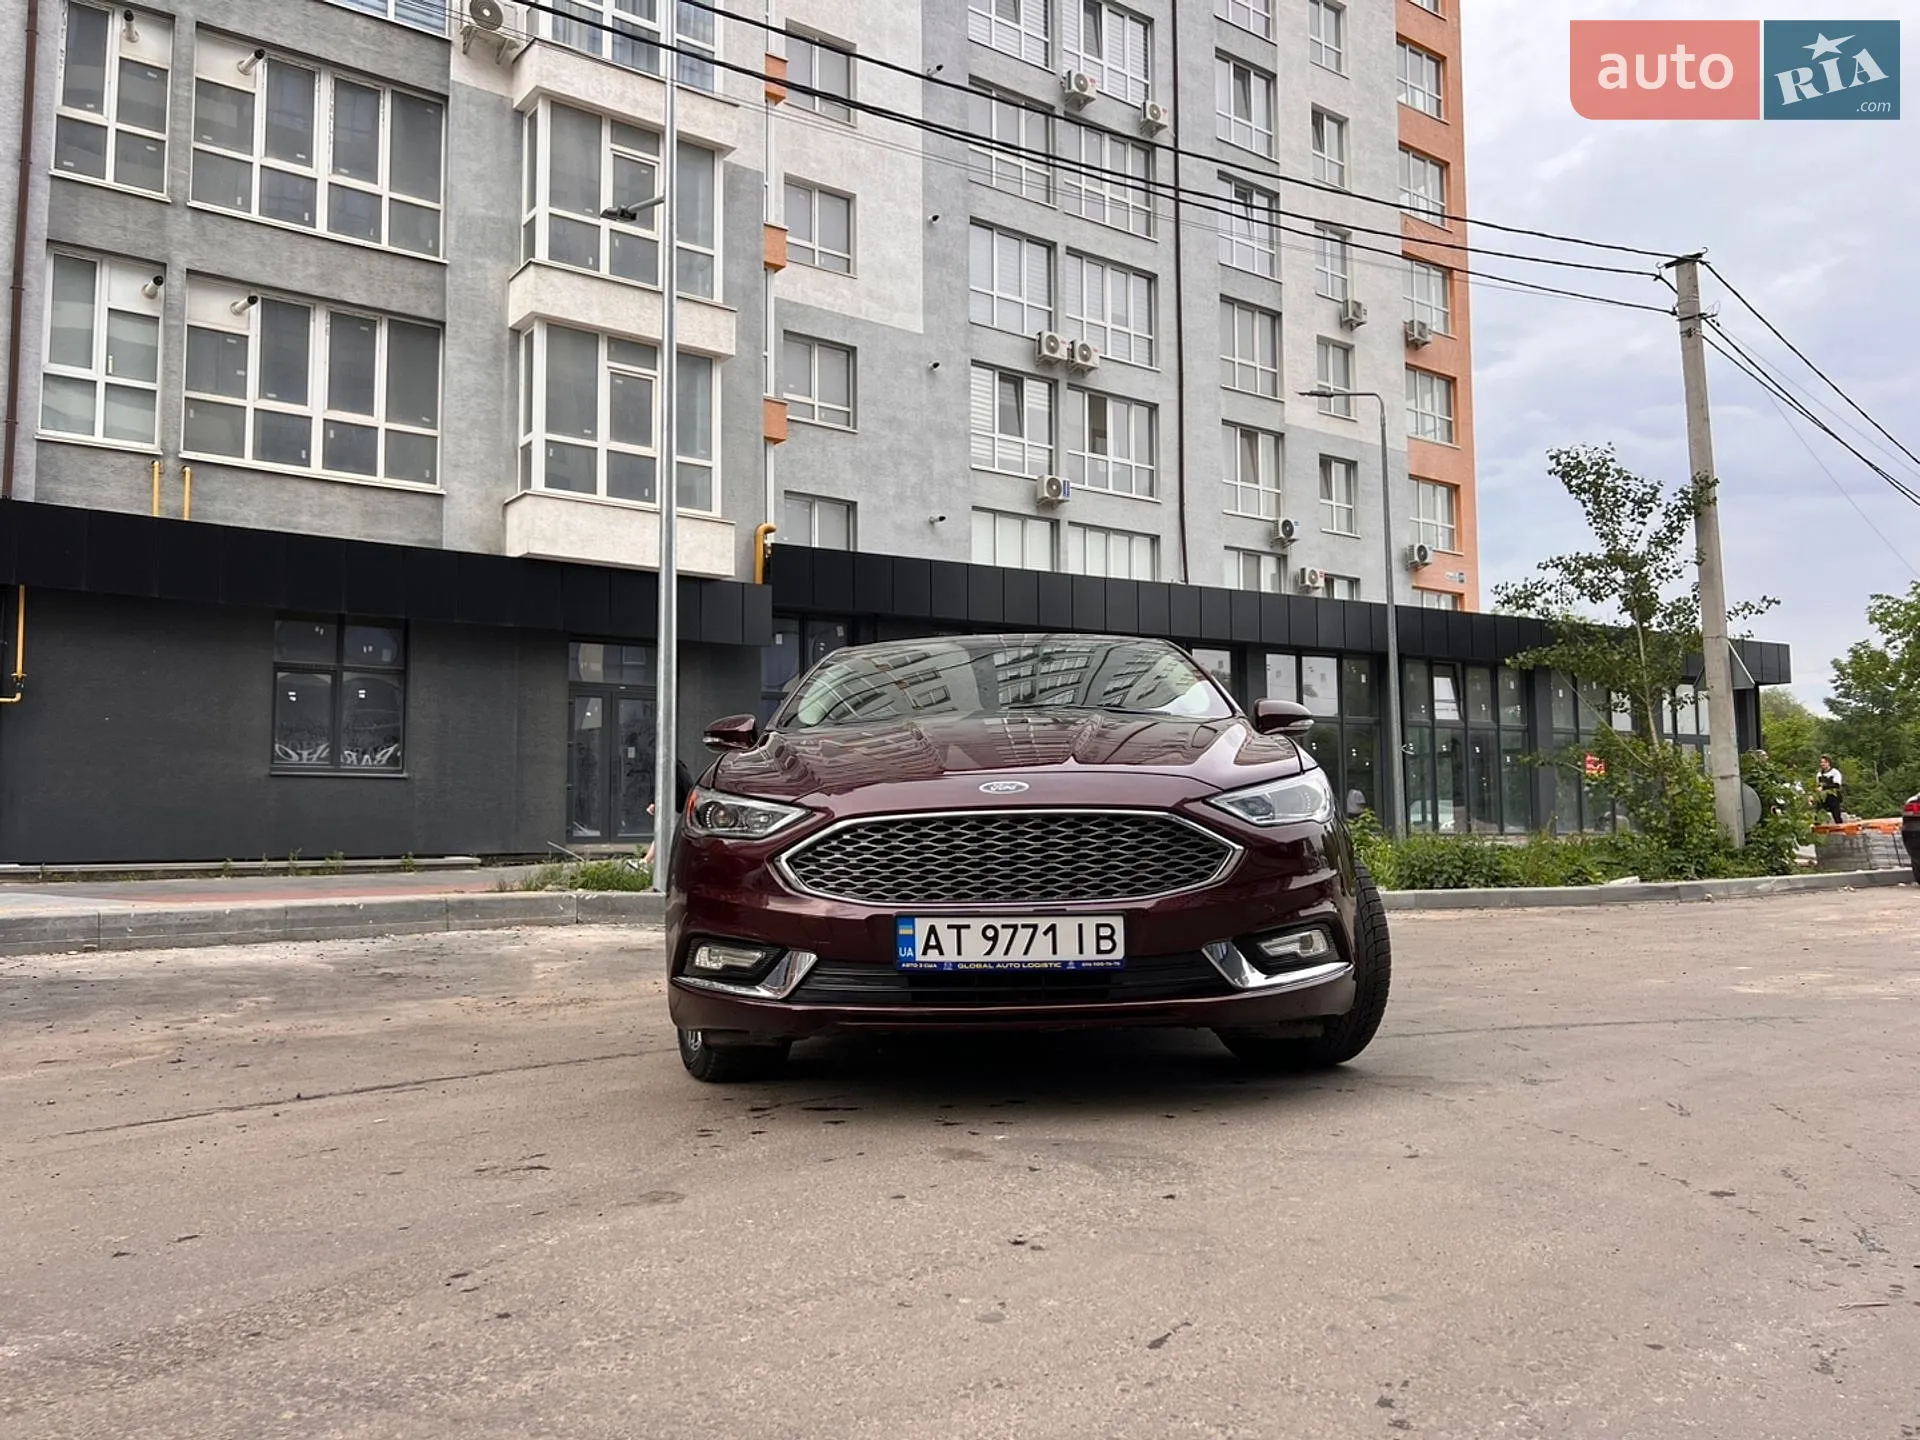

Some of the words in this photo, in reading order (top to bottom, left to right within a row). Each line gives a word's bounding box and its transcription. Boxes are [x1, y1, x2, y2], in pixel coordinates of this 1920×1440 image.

[921, 923, 971, 956] AT
[981, 923, 1058, 956] 9771
[1077, 923, 1118, 955] IB
[899, 947, 914, 957] UA
